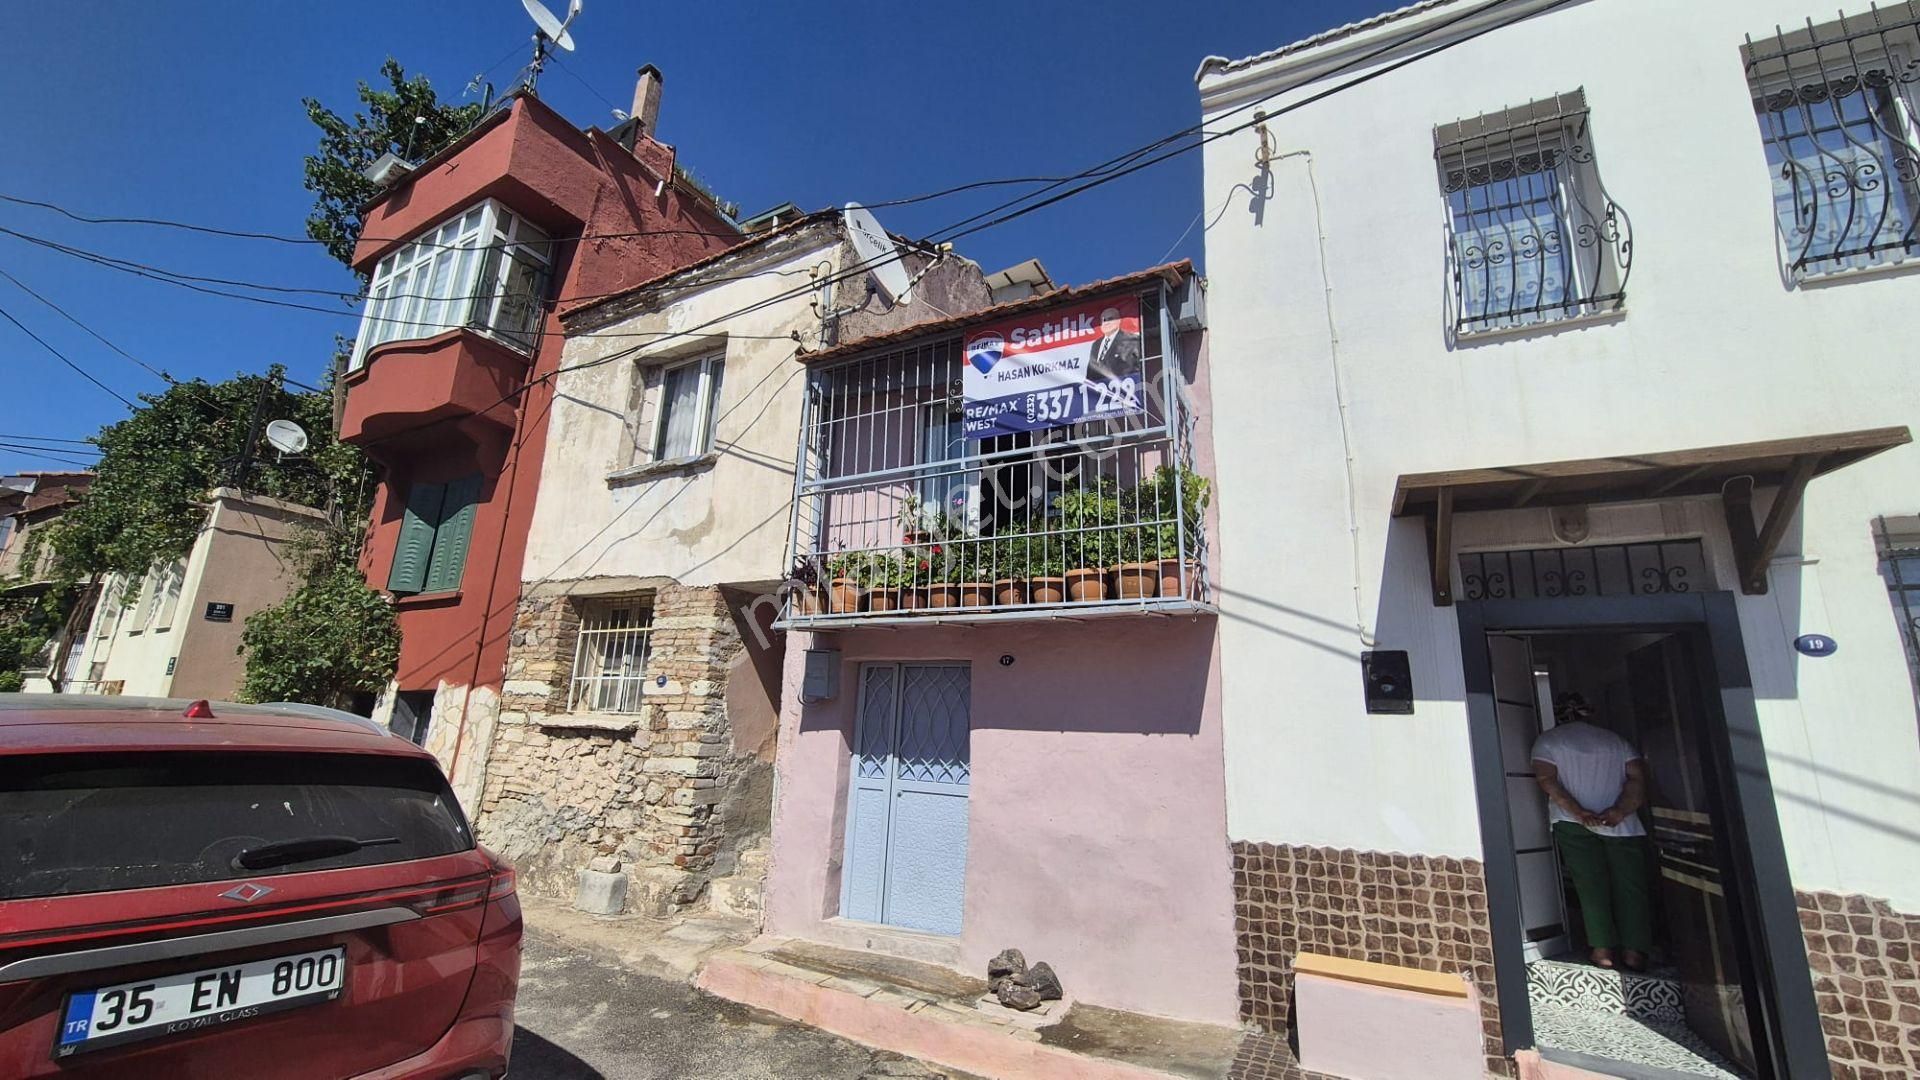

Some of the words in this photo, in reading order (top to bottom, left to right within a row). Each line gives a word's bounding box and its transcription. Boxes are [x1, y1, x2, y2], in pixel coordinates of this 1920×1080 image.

[1010, 313, 1096, 350] Satılık
[998, 366, 1031, 382] HASAN
[1031, 358, 1080, 376] KORKMAZ
[966, 400, 1018, 419] RE/MAX
[1036, 387, 1074, 422] 337
[966, 417, 998, 432] WEST
[1808, 639, 1824, 649] 19
[67, 1019, 88, 1034] TR
[96, 983, 156, 1031] 35
[190, 969, 241, 1013] EN
[272, 954, 336, 996] 800
[167, 1016, 212, 1034] ROYAL
[220, 1006, 259, 1022] CLASS
